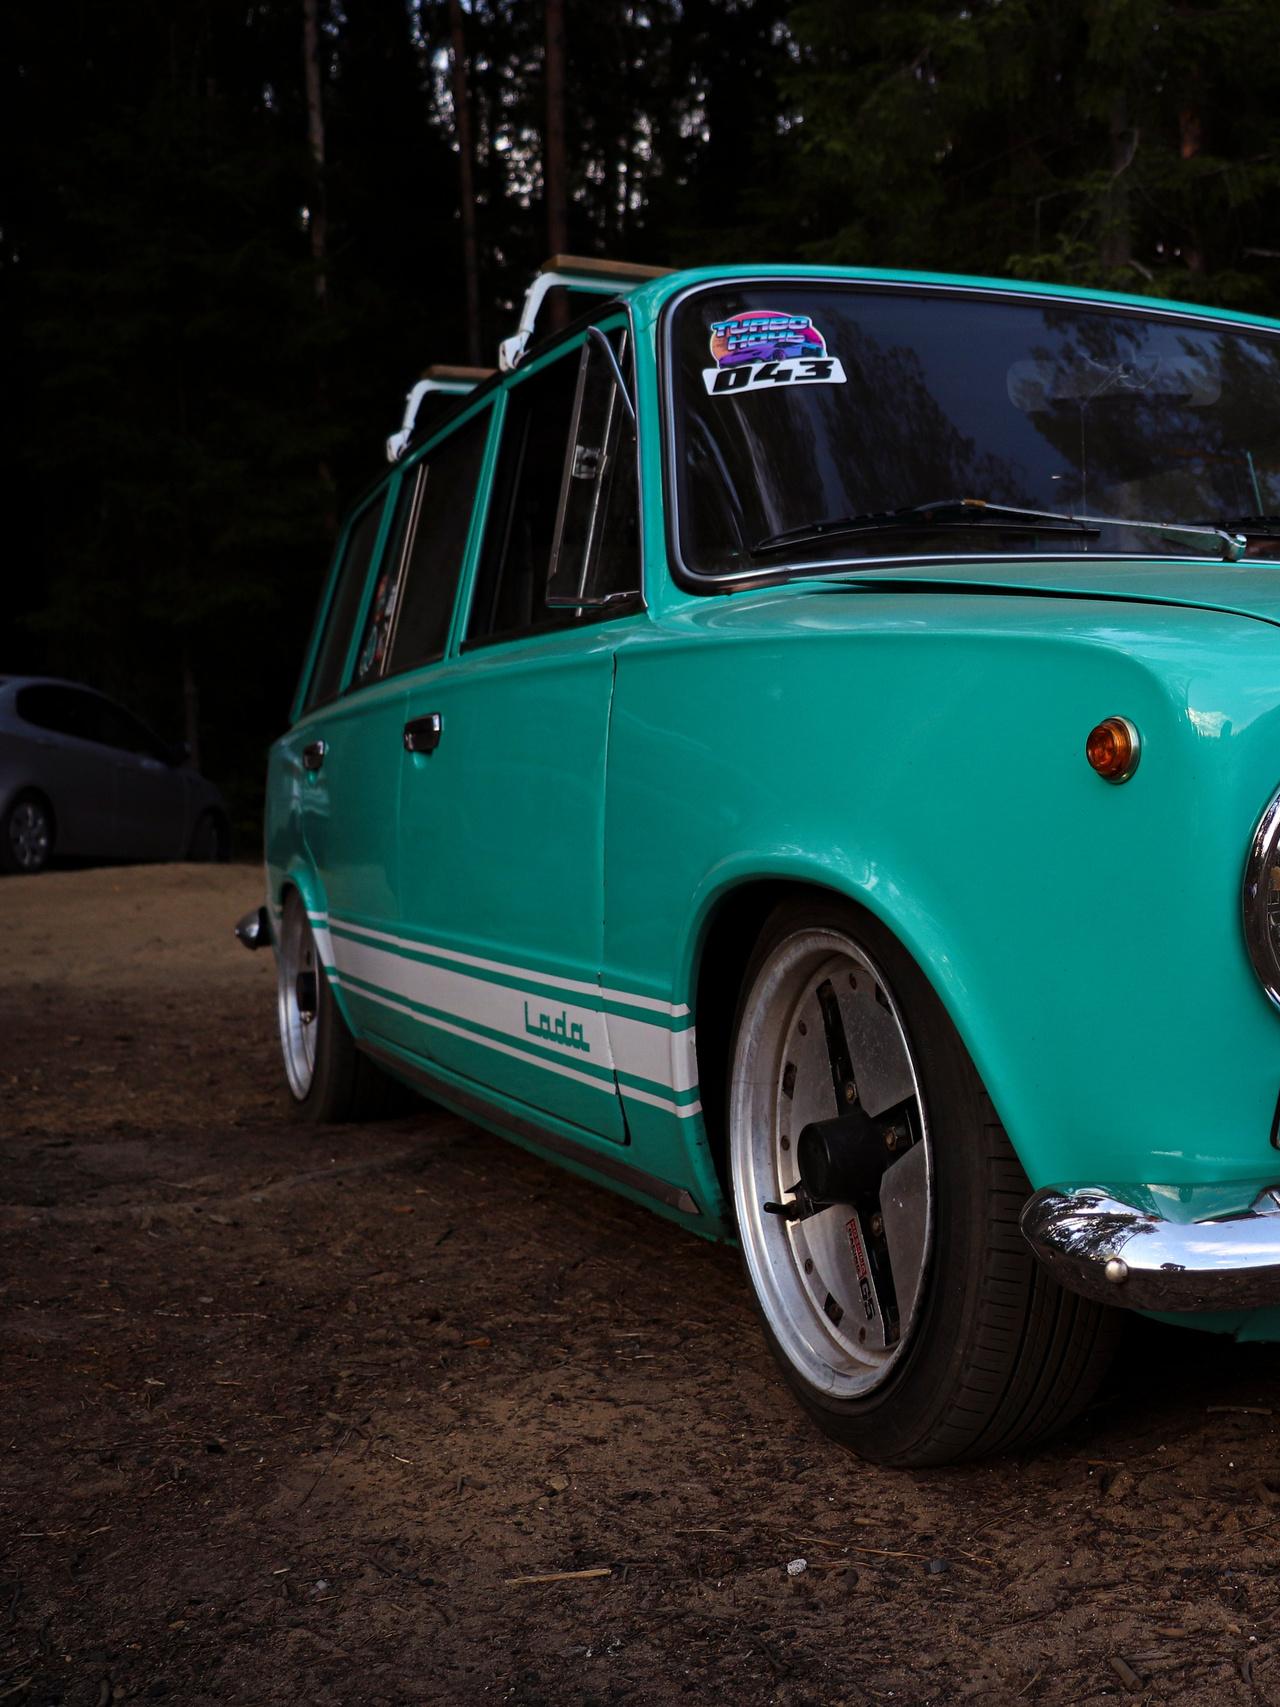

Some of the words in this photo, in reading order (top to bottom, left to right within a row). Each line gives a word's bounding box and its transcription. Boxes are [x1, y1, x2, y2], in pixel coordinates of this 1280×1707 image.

[713, 317, 810, 337] TURBO
[712, 360, 835, 393] 043
[524, 1000, 590, 1052] Lada
[859, 1276, 876, 1321] G5
